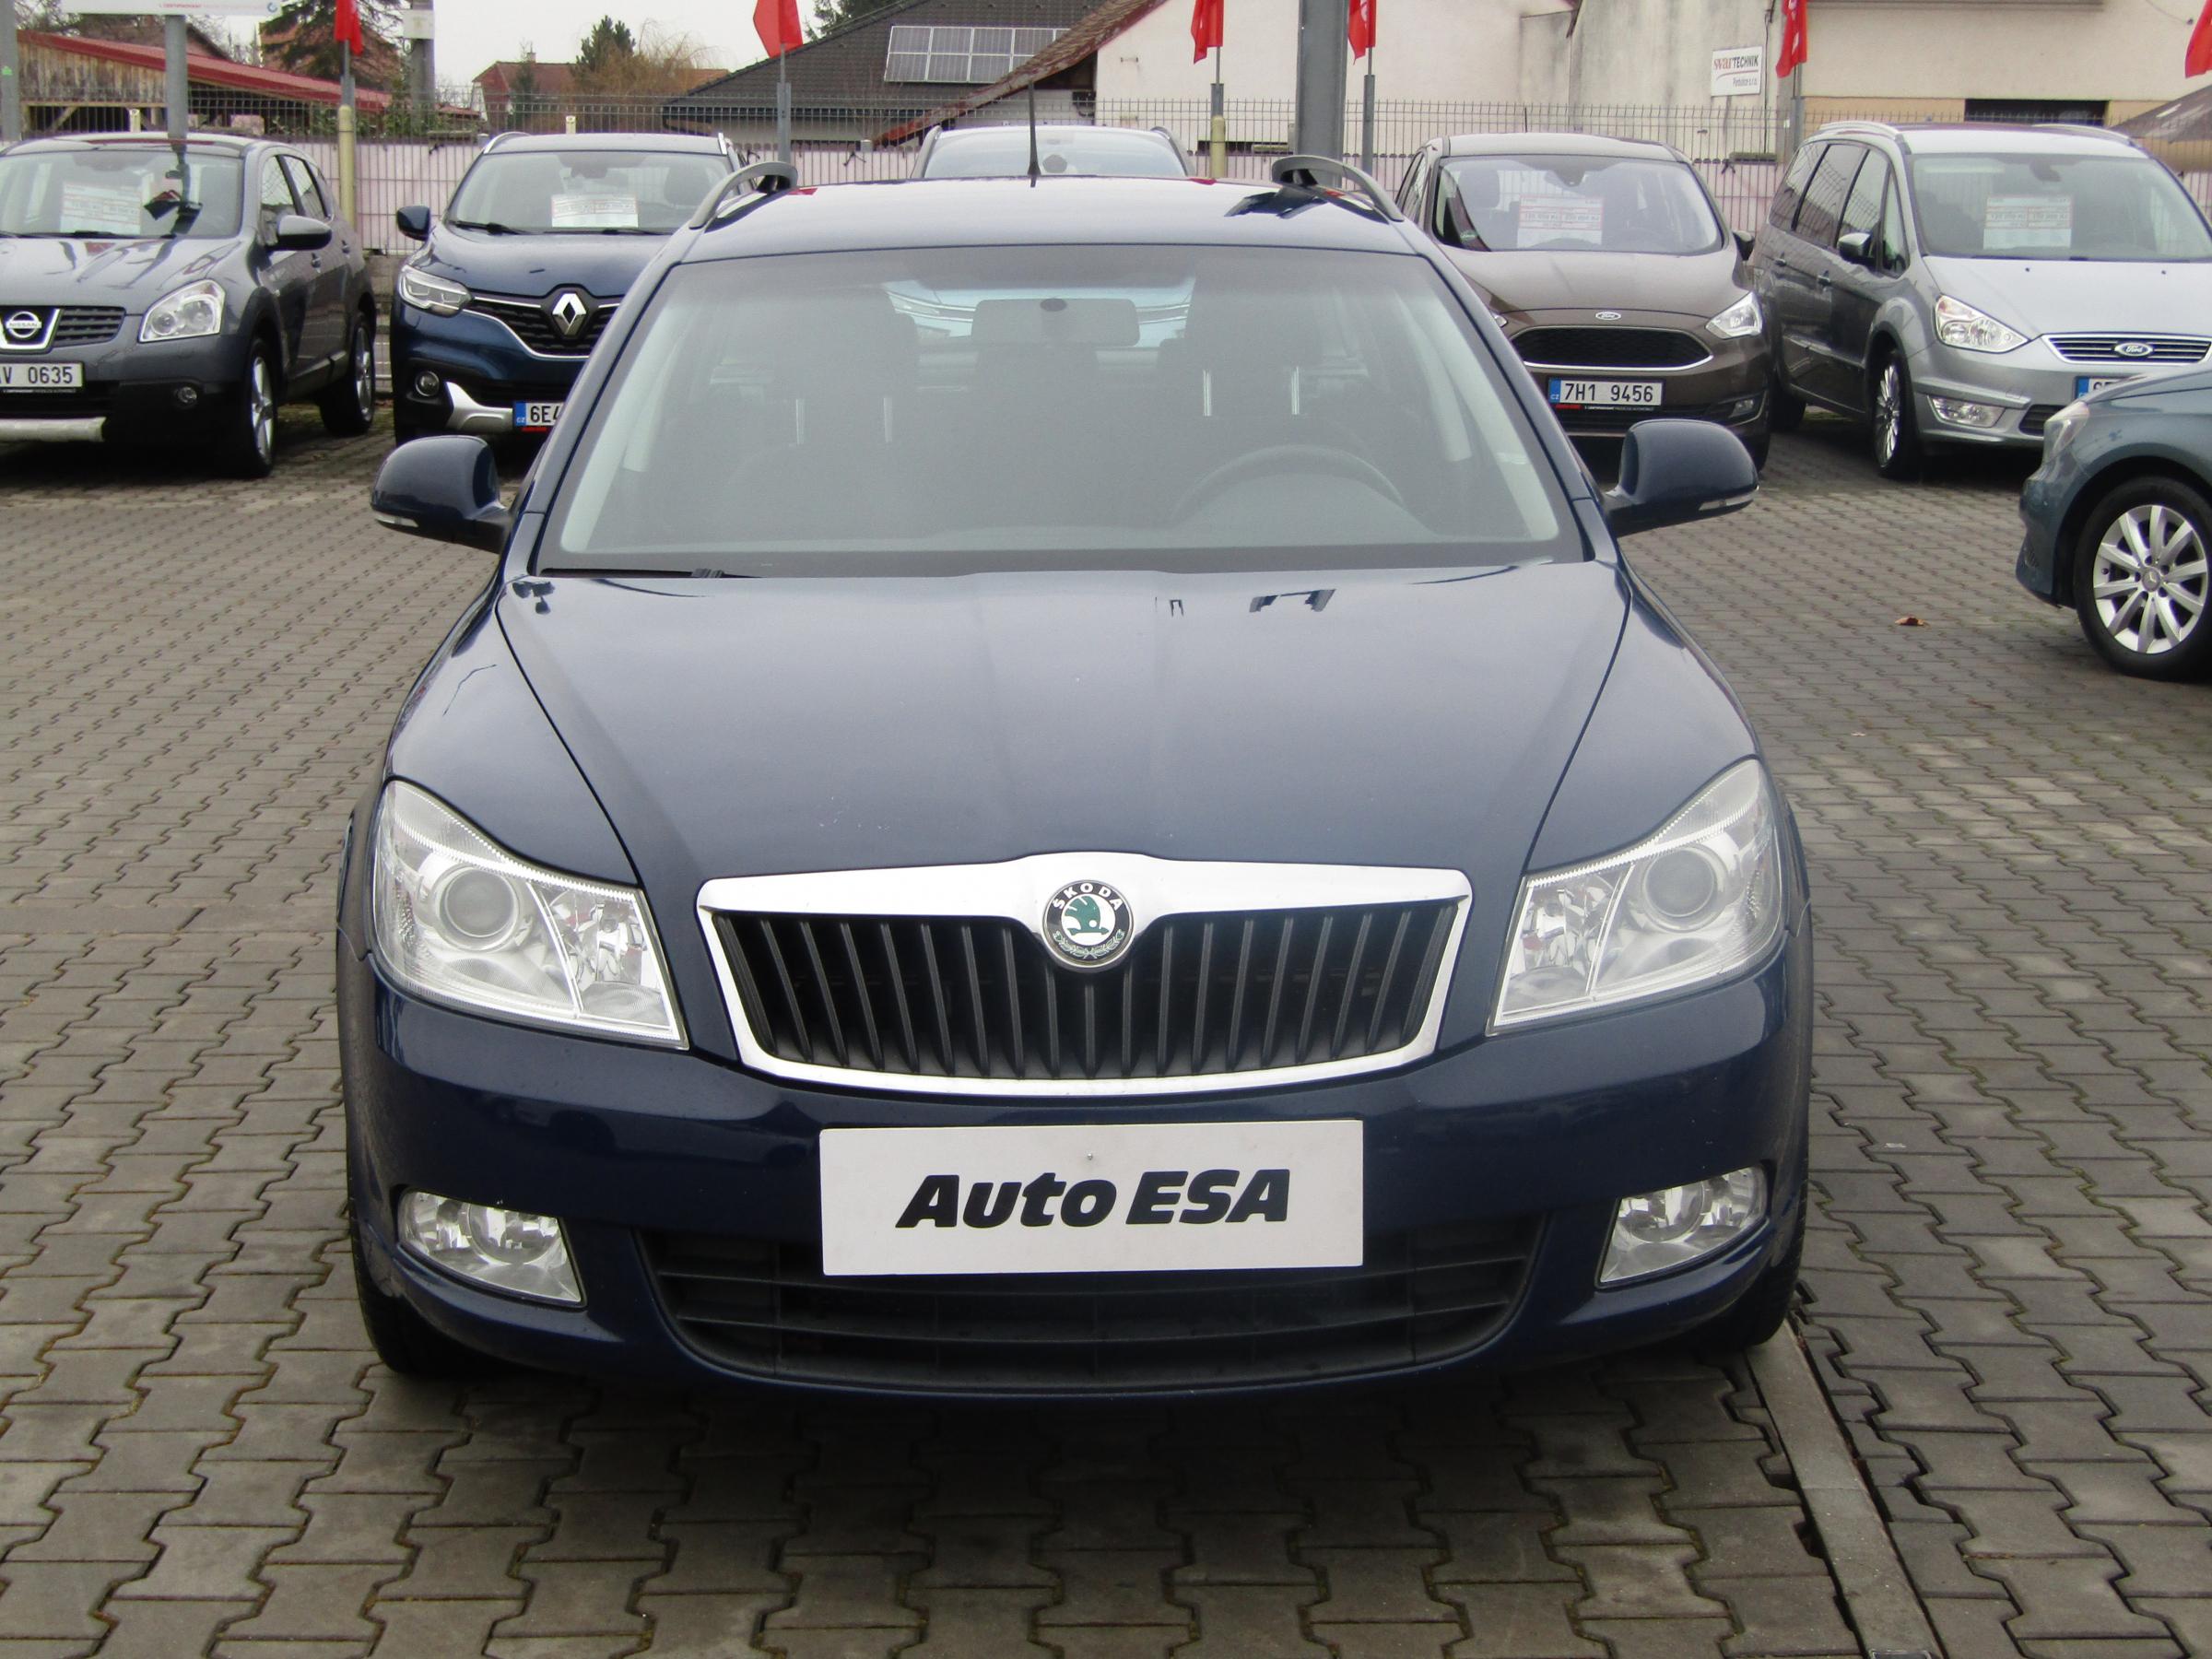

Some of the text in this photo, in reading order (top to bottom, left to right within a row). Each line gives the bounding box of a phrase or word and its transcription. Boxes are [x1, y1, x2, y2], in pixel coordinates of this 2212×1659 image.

[2124, 345, 2144, 354] Ford
[28, 367, 73, 384] 0635
[1565, 382, 1653, 403] 7H1 9456
[895, 1169, 1290, 1229] Auto ESA
